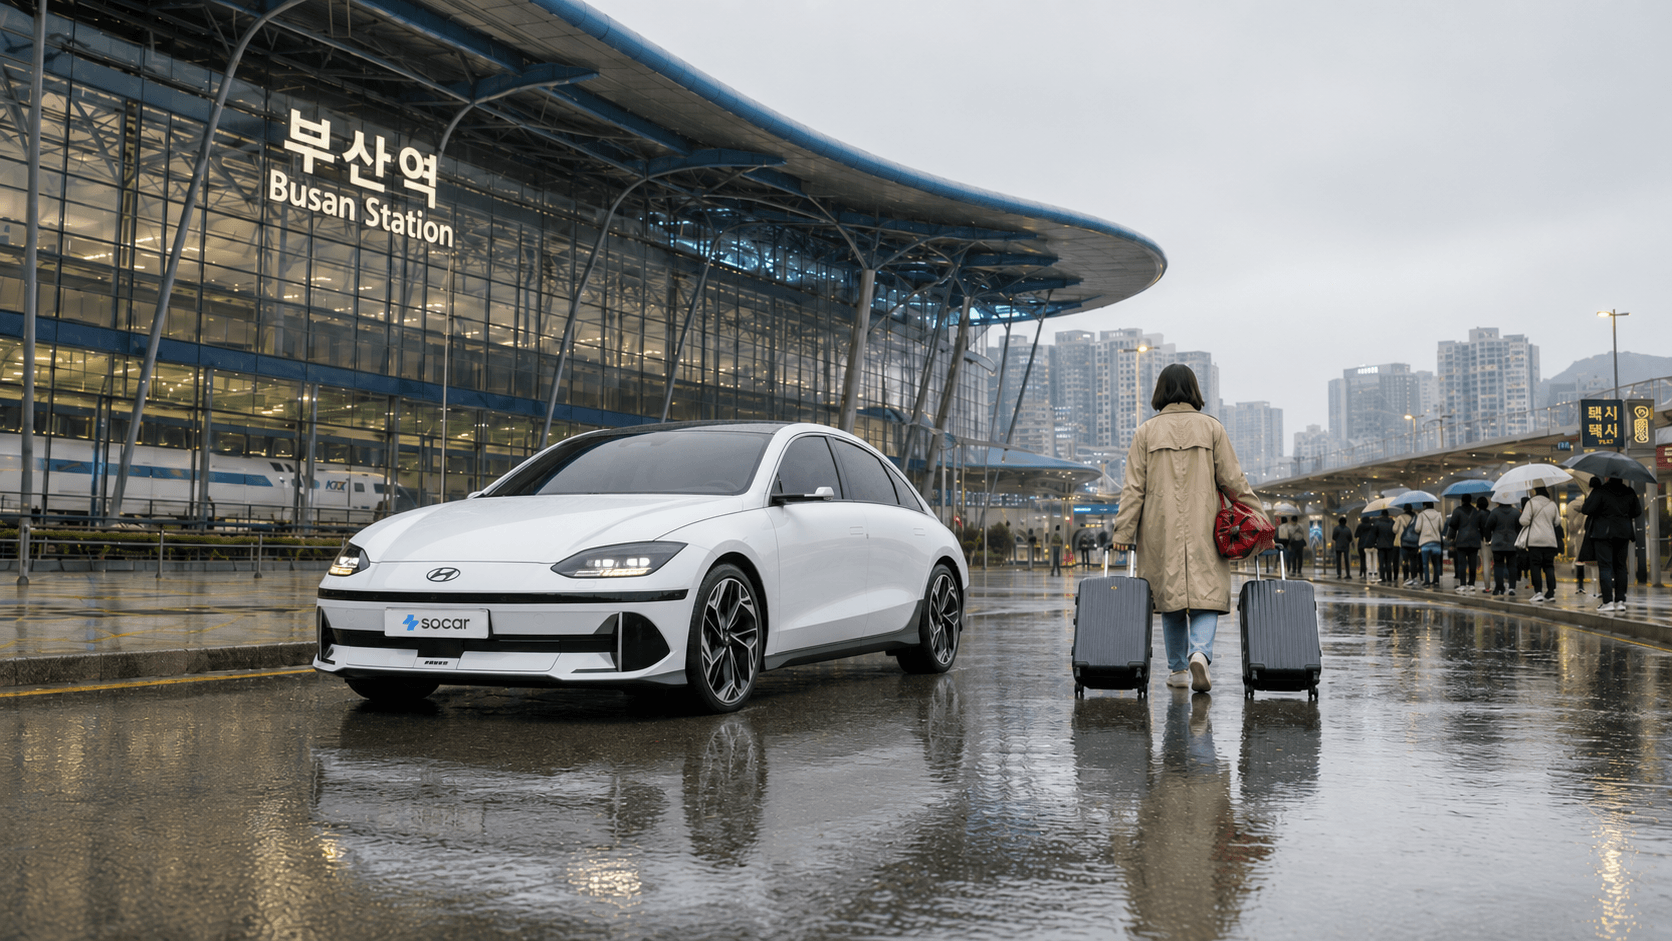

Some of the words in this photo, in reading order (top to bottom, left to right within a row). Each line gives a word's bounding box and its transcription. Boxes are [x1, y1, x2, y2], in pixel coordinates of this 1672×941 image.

[284, 108, 438, 209] 부산역
[269, 169, 356, 221] Busan
[365, 197, 454, 247] Station
[325, 480, 347, 491] KTX
[421, 618, 471, 630] socar
